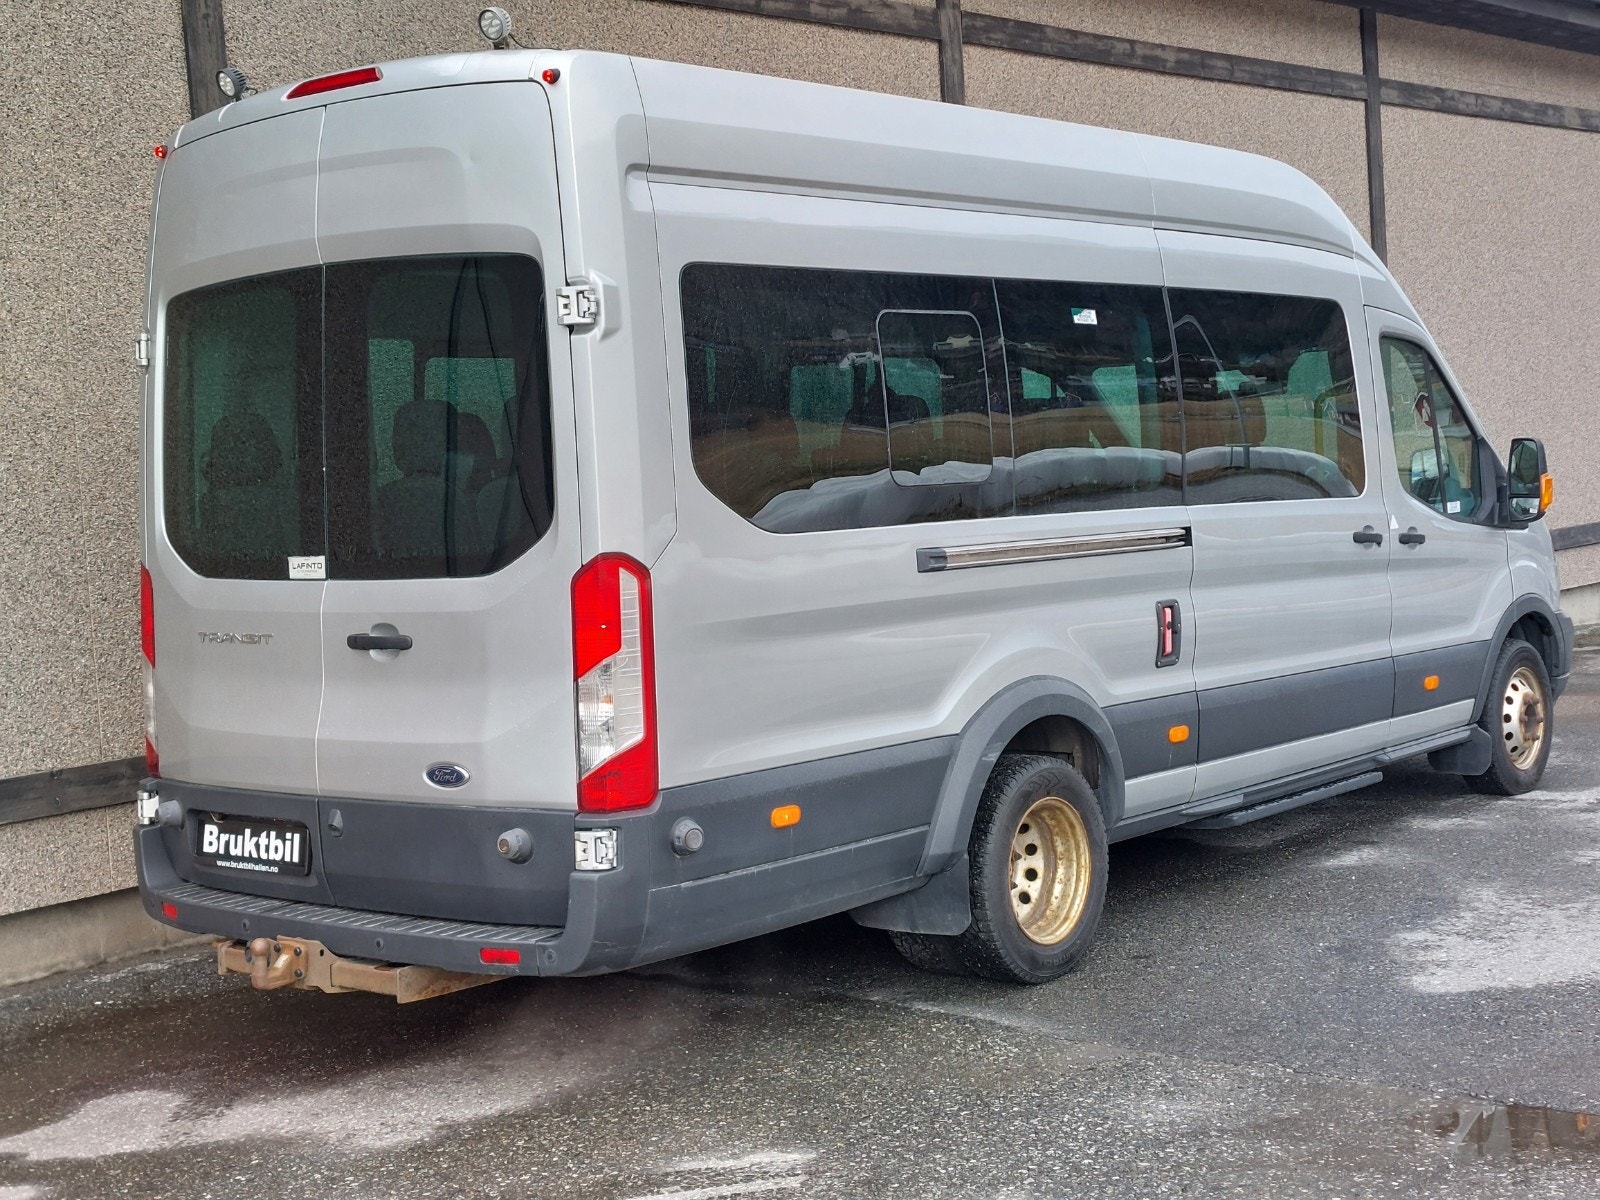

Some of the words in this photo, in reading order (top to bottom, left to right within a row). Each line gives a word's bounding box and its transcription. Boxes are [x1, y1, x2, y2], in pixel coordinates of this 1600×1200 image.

[292, 562, 323, 570] LAFINTO
[198, 632, 274, 645] TRANSIT
[433, 769, 457, 781] Ford
[203, 823, 300, 863] Bruktbil
[216, 860, 279, 873] www.bruktbilhallen.no
